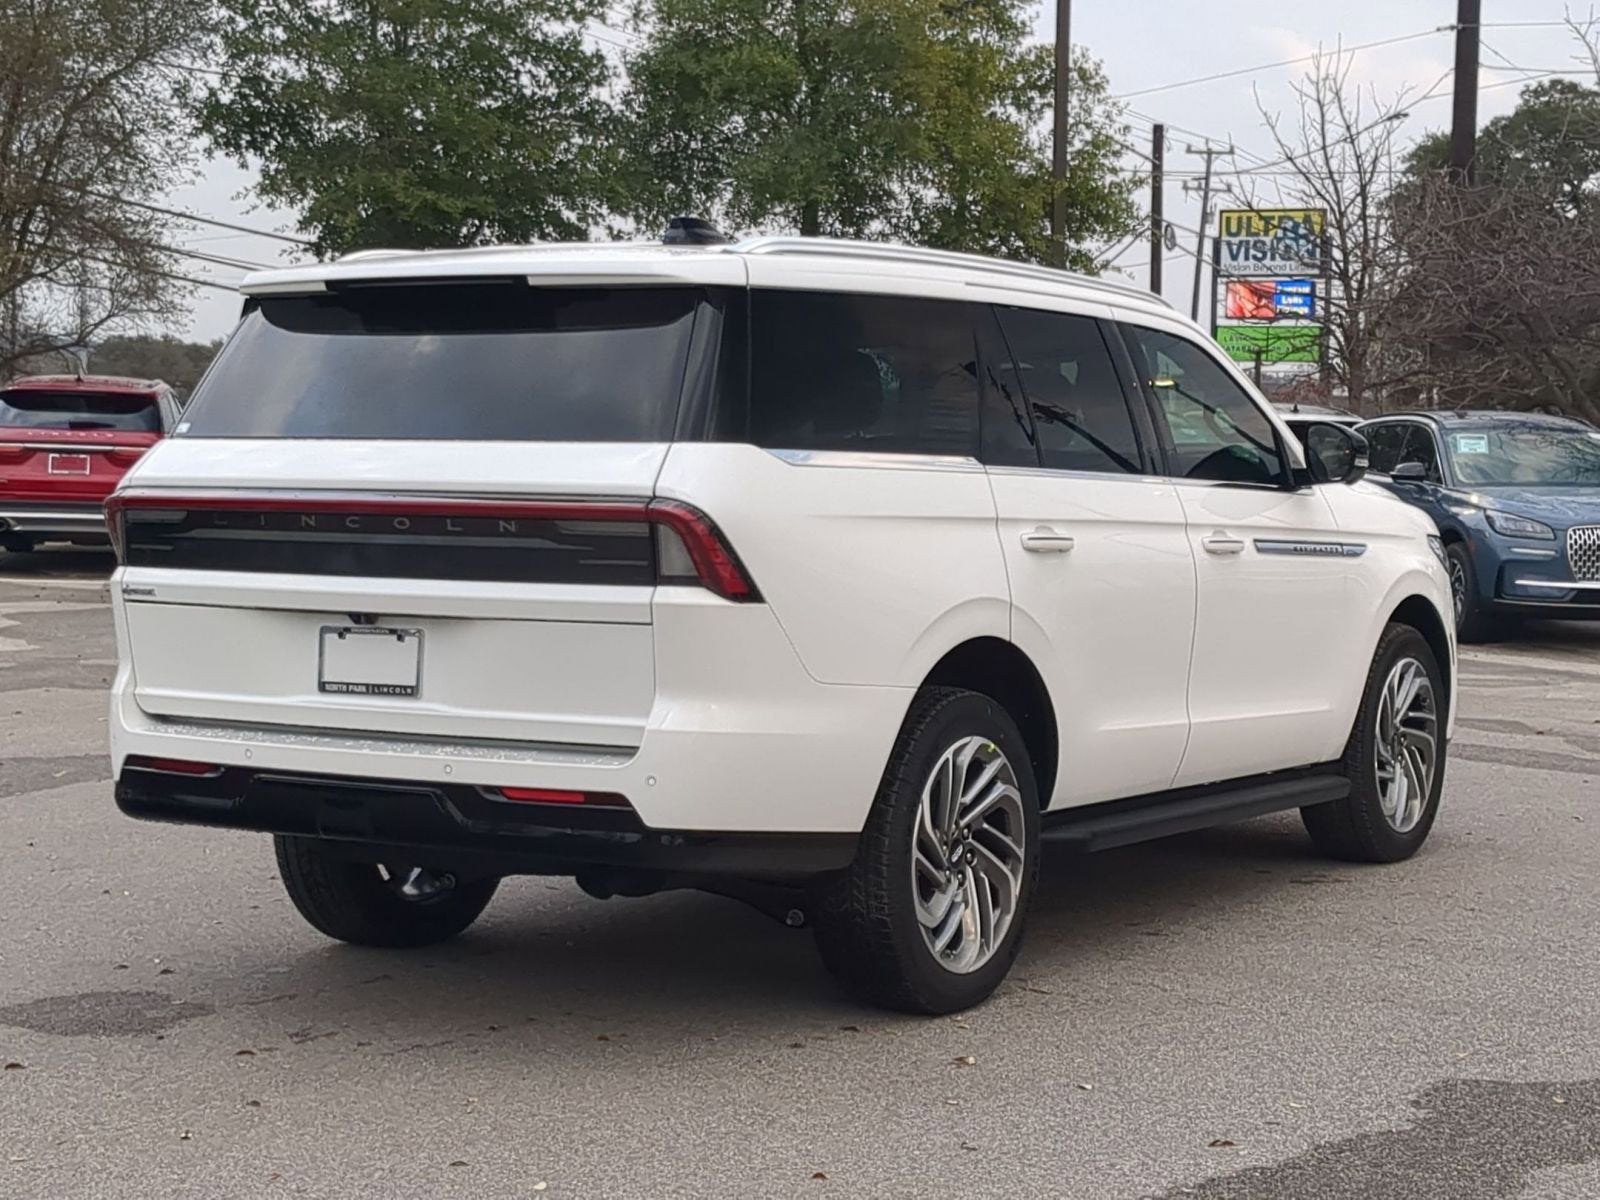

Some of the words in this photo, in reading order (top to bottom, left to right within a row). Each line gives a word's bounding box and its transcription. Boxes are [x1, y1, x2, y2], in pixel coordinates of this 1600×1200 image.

[213, 513, 518, 532] LINCOLN
[348, 684, 367, 692] PARK
[374, 686, 412, 694] LINCOLN
